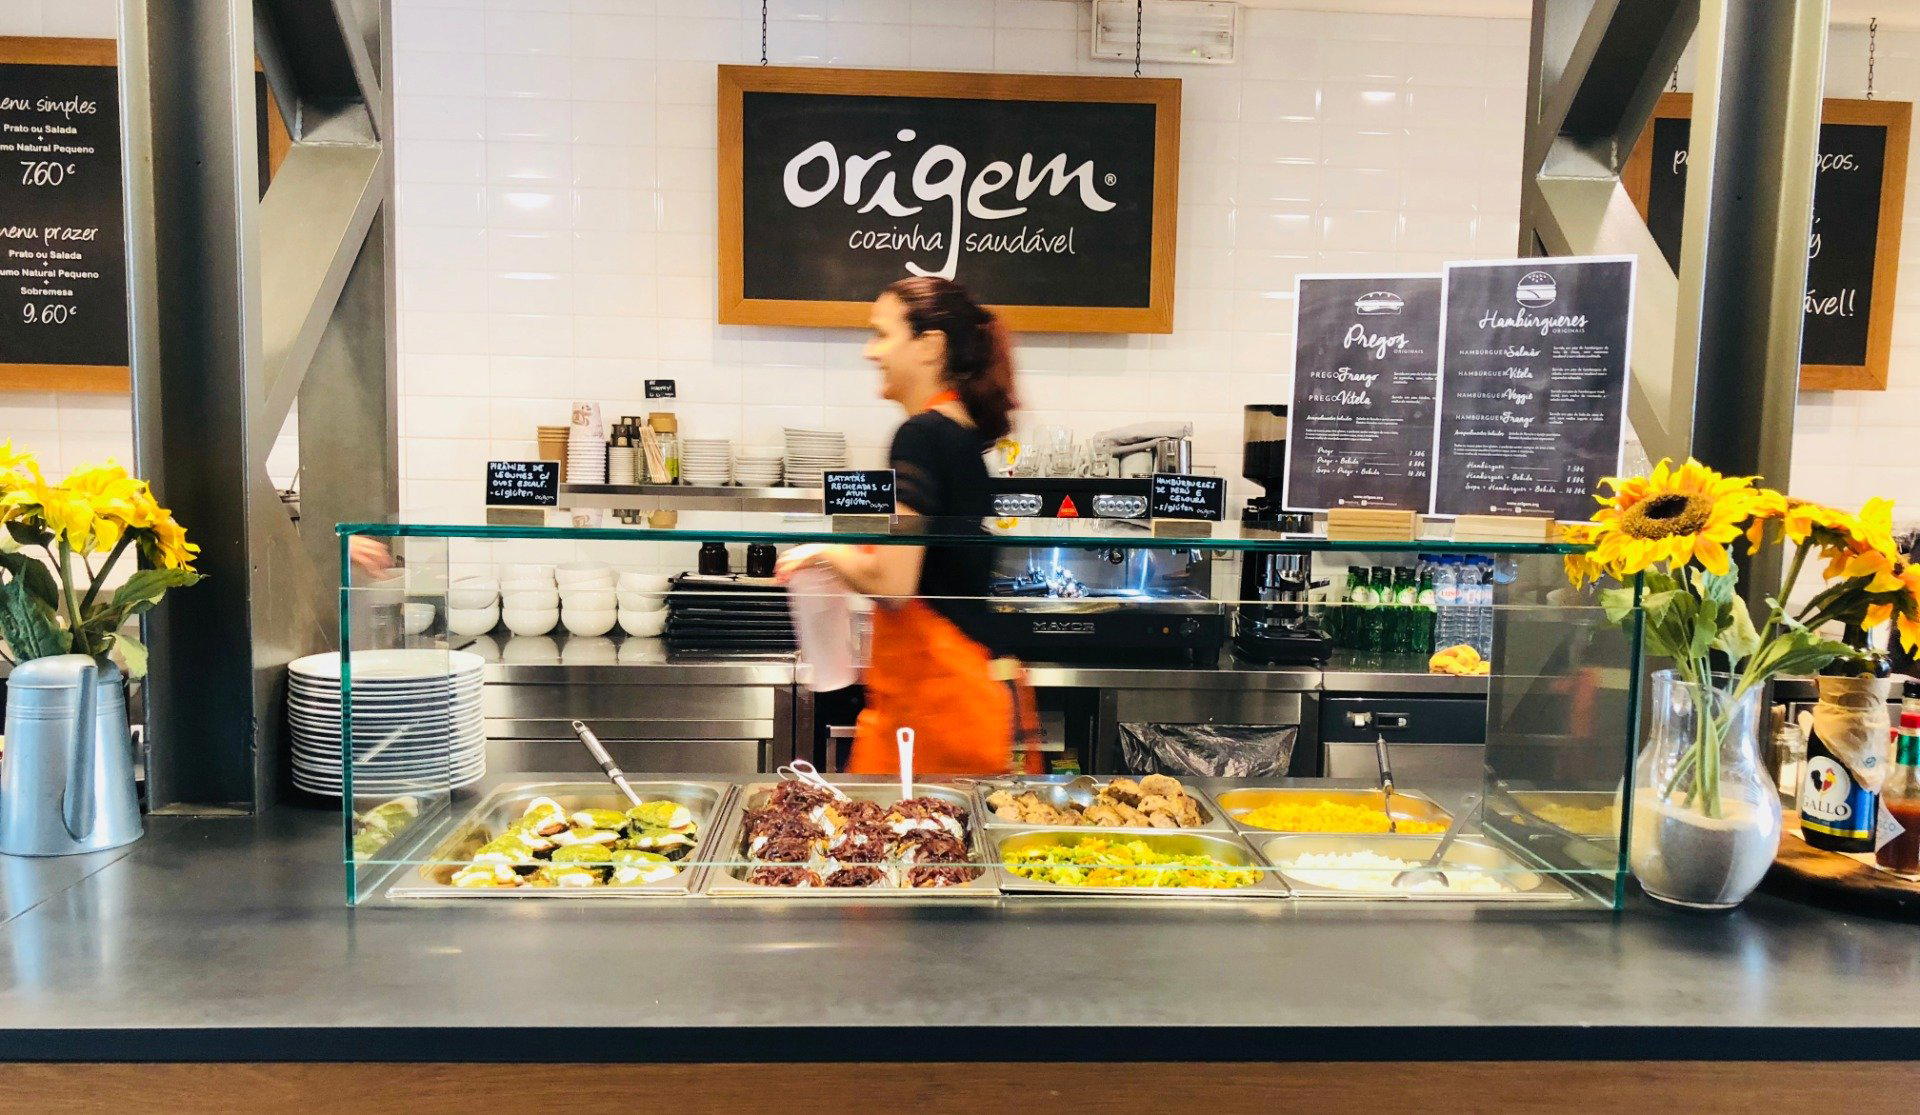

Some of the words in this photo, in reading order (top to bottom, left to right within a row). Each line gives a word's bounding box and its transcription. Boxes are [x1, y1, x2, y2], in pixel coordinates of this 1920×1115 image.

[0, 97, 31, 110] enu
[36, 95, 97, 120] simples
[3, 123, 29, 133] Prato
[44, 125, 78, 134] Salada
[0, 144, 15, 152] mo
[16, 142, 51, 153] Natural
[53, 144, 95, 155] Pequeno
[783, 128, 1117, 281] origem
[44, 226, 99, 247] prazer
[848, 224, 944, 251] cozinha
[965, 226, 1076, 255] saudável
[8, 249, 34, 259] Prato
[36, 251, 48, 259] ou
[50, 250, 82, 260] Salada
[22, 268, 56, 278] Natural
[58, 269, 100, 279] Pequeno
[20, 286, 74, 297] Sobremesa
[1805, 288, 1856, 317] ável!
[1478, 307, 1589, 336] Hambúrgueres
[1343, 323, 1410, 360] Pregos
[1310, 371, 1340, 379] PREGO
[1338, 366, 1380, 388] Frango
[1505, 366, 1534, 379] Vitela
[1308, 394, 1338, 402] PREGO
[1336, 390, 1372, 405] Vitela
[1502, 411, 1535, 428] Frango
